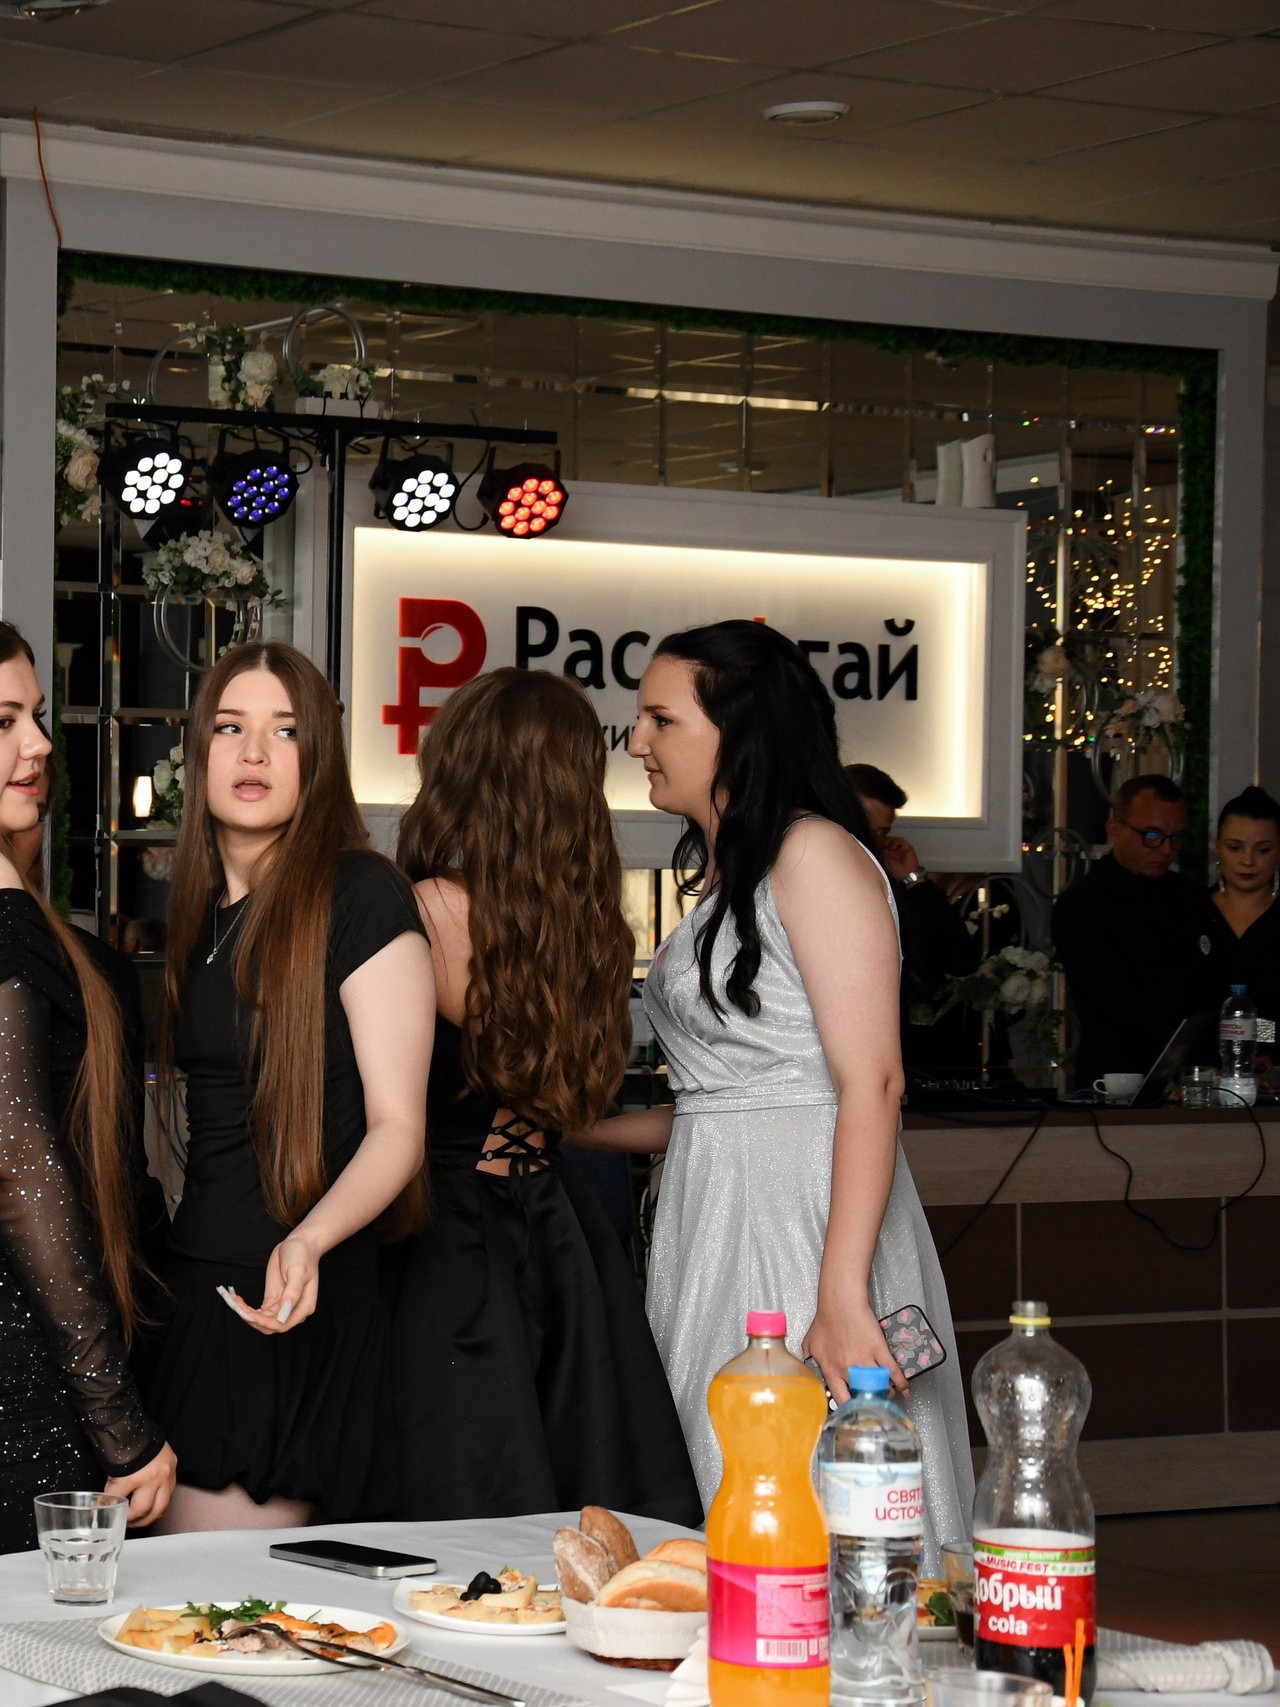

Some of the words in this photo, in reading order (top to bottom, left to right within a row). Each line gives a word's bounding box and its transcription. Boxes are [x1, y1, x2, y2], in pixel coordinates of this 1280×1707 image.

[887, 1486, 924, 1504] СВЯТ
[985, 1556, 1017, 1570] MUSIC
[1020, 1562, 1050, 1574] FEST
[988, 1614, 1028, 1636] cola
